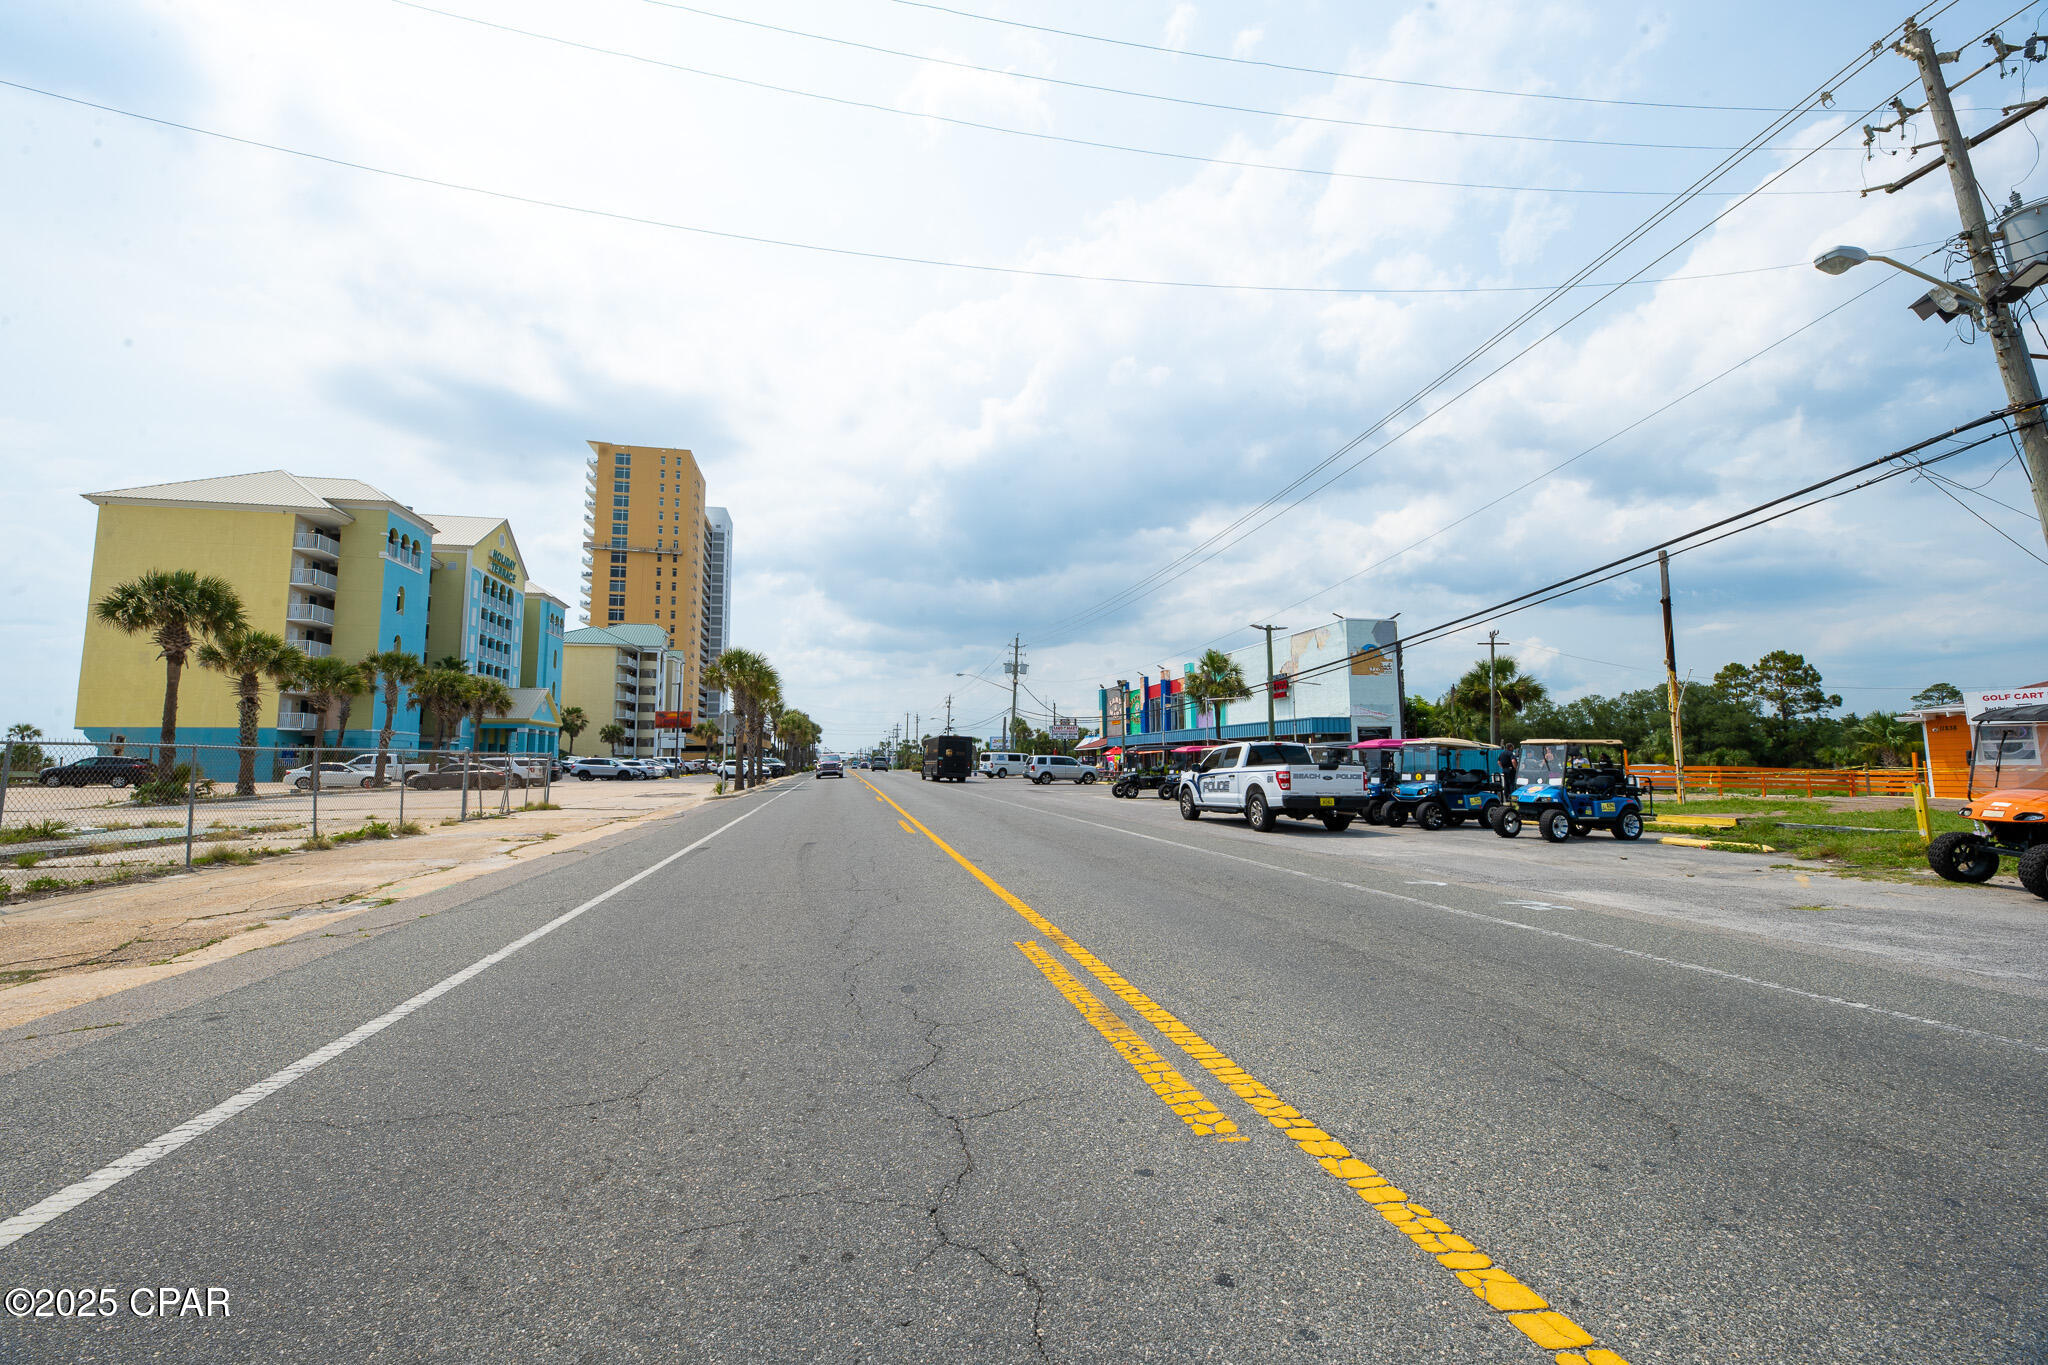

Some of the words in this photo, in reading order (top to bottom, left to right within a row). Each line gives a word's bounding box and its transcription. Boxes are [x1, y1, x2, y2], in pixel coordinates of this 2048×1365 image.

[492, 549, 516, 571] HOLIDAY
[491, 560, 517, 584] TERRACE
[1982, 694, 2011, 702] GOLF
[2014, 691, 2044, 700] CART
[1203, 780, 1231, 793] POLICE
